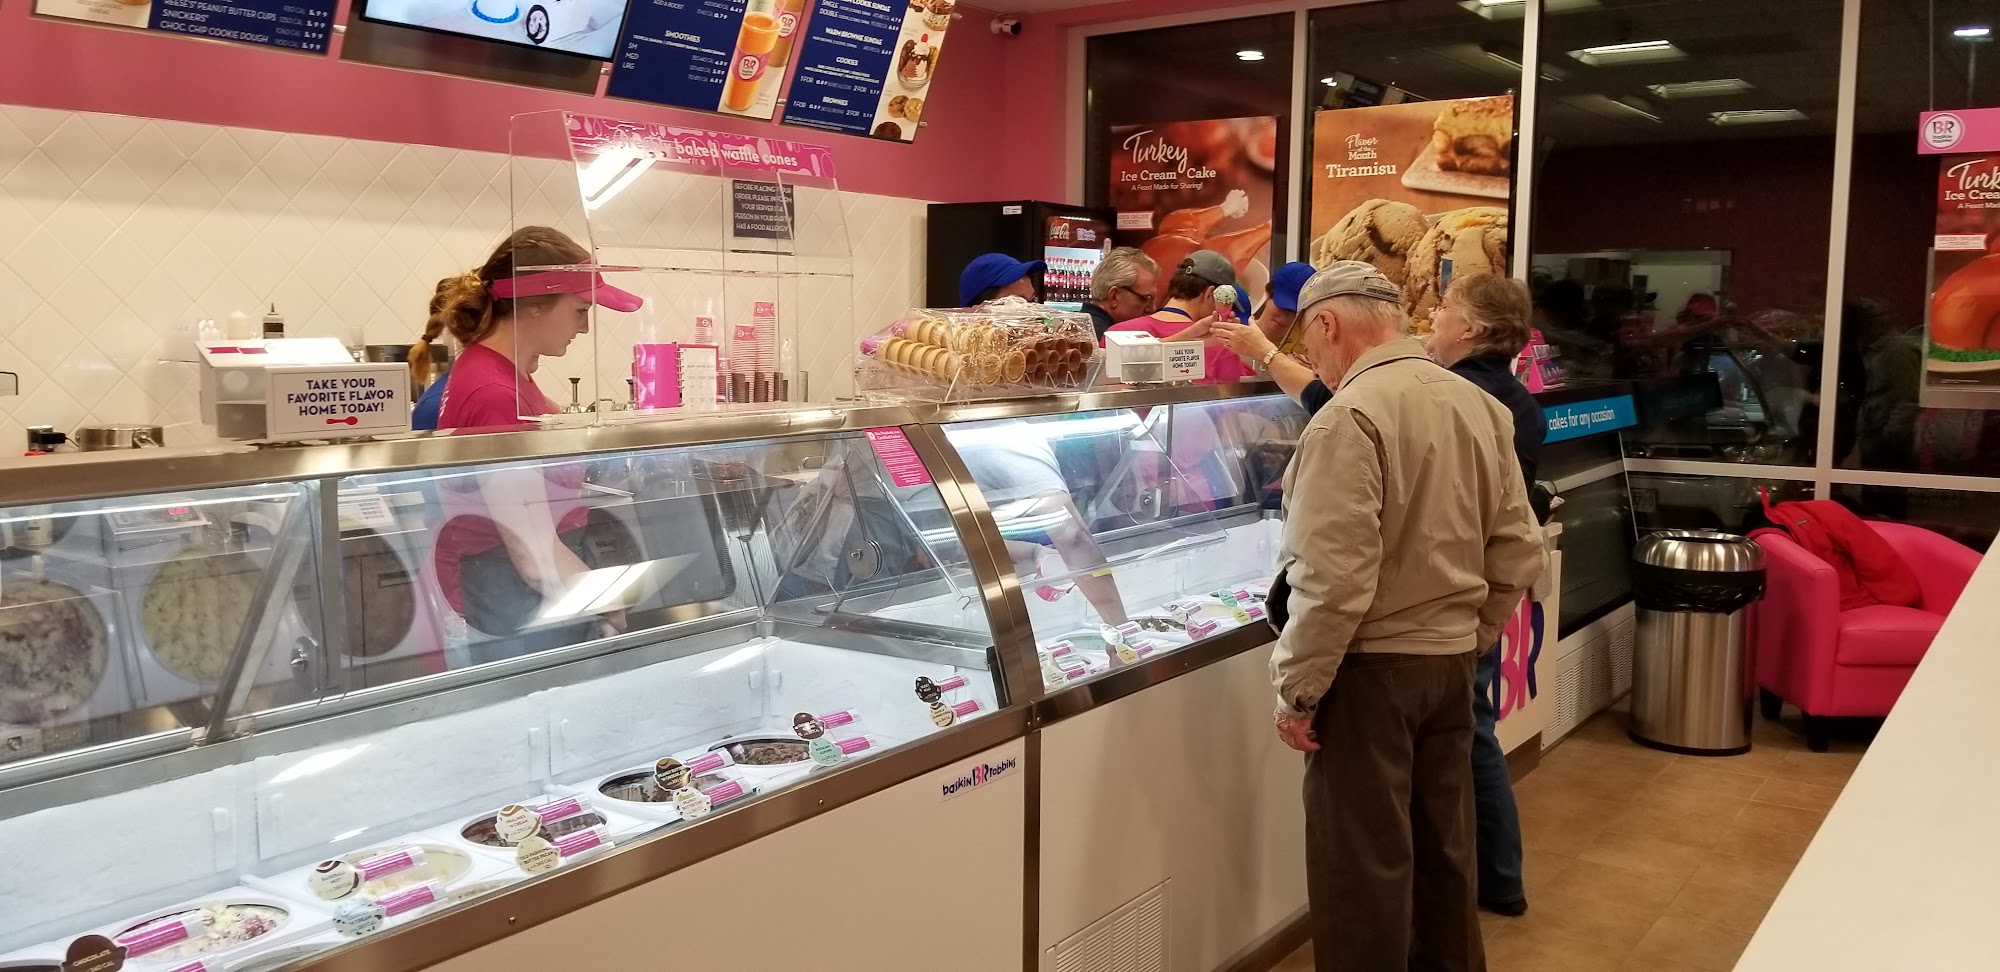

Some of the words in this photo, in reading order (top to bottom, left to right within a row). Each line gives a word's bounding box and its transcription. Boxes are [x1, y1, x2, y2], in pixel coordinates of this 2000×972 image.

[197, 2, 228, 13] PEANUT
[228, 6, 257, 18] BUTTER
[257, 11, 277, 21] CUPS
[819, 8, 839, 18] DOUBLE
[188, 24, 208, 34] CHIP
[208, 27, 239, 38] COOKIE
[240, 31, 269, 42] DOUGH
[665, 30, 701, 43] SMOOTHIES
[625, 52, 639, 60] MED
[836, 56, 859, 66] COOKIES
[822, 96, 849, 107] BROWNIES
[1932, 121, 1955, 134] BR
[1345, 133, 1379, 149] Flavor
[674, 138, 719, 159] baked
[721, 145, 760, 163] waffle
[762, 152, 798, 166] cones
[1123, 130, 1188, 174] Turkey
[1348, 150, 1377, 160] Month
[1121, 171, 1138, 182] Ice
[1140, 170, 1177, 181] Cream
[1186, 166, 1217, 179] Cake
[1326, 162, 1397, 178] Tiramisu
[754, 184, 776, 192] PLACING
[1180, 182, 1203, 190] Sharing!
[1944, 191, 1966, 200] Ice
[741, 203, 756, 211] YOUR
[756, 204, 774, 212] SERVER
[306, 379, 338, 390] TAKE
[341, 378, 375, 389] YOUR
[287, 391, 346, 404] FAVORITE
[349, 389, 394, 401] FLAVOR
[299, 404, 337, 416] HOME
[340, 402, 384, 414] TODAY!
[1548, 410, 1568, 431] cakes
[1567, 408, 1578, 427] for
[1579, 412, 1591, 429] any
[1591, 405, 1616, 423] occasion
[1492, 599, 1544, 722] BR
[943, 777, 972, 796] baskin
[972, 763, 989, 787] BR
[990, 757, 1016, 778] robbins
[72, 948, 112, 967] CHOCOLATE
